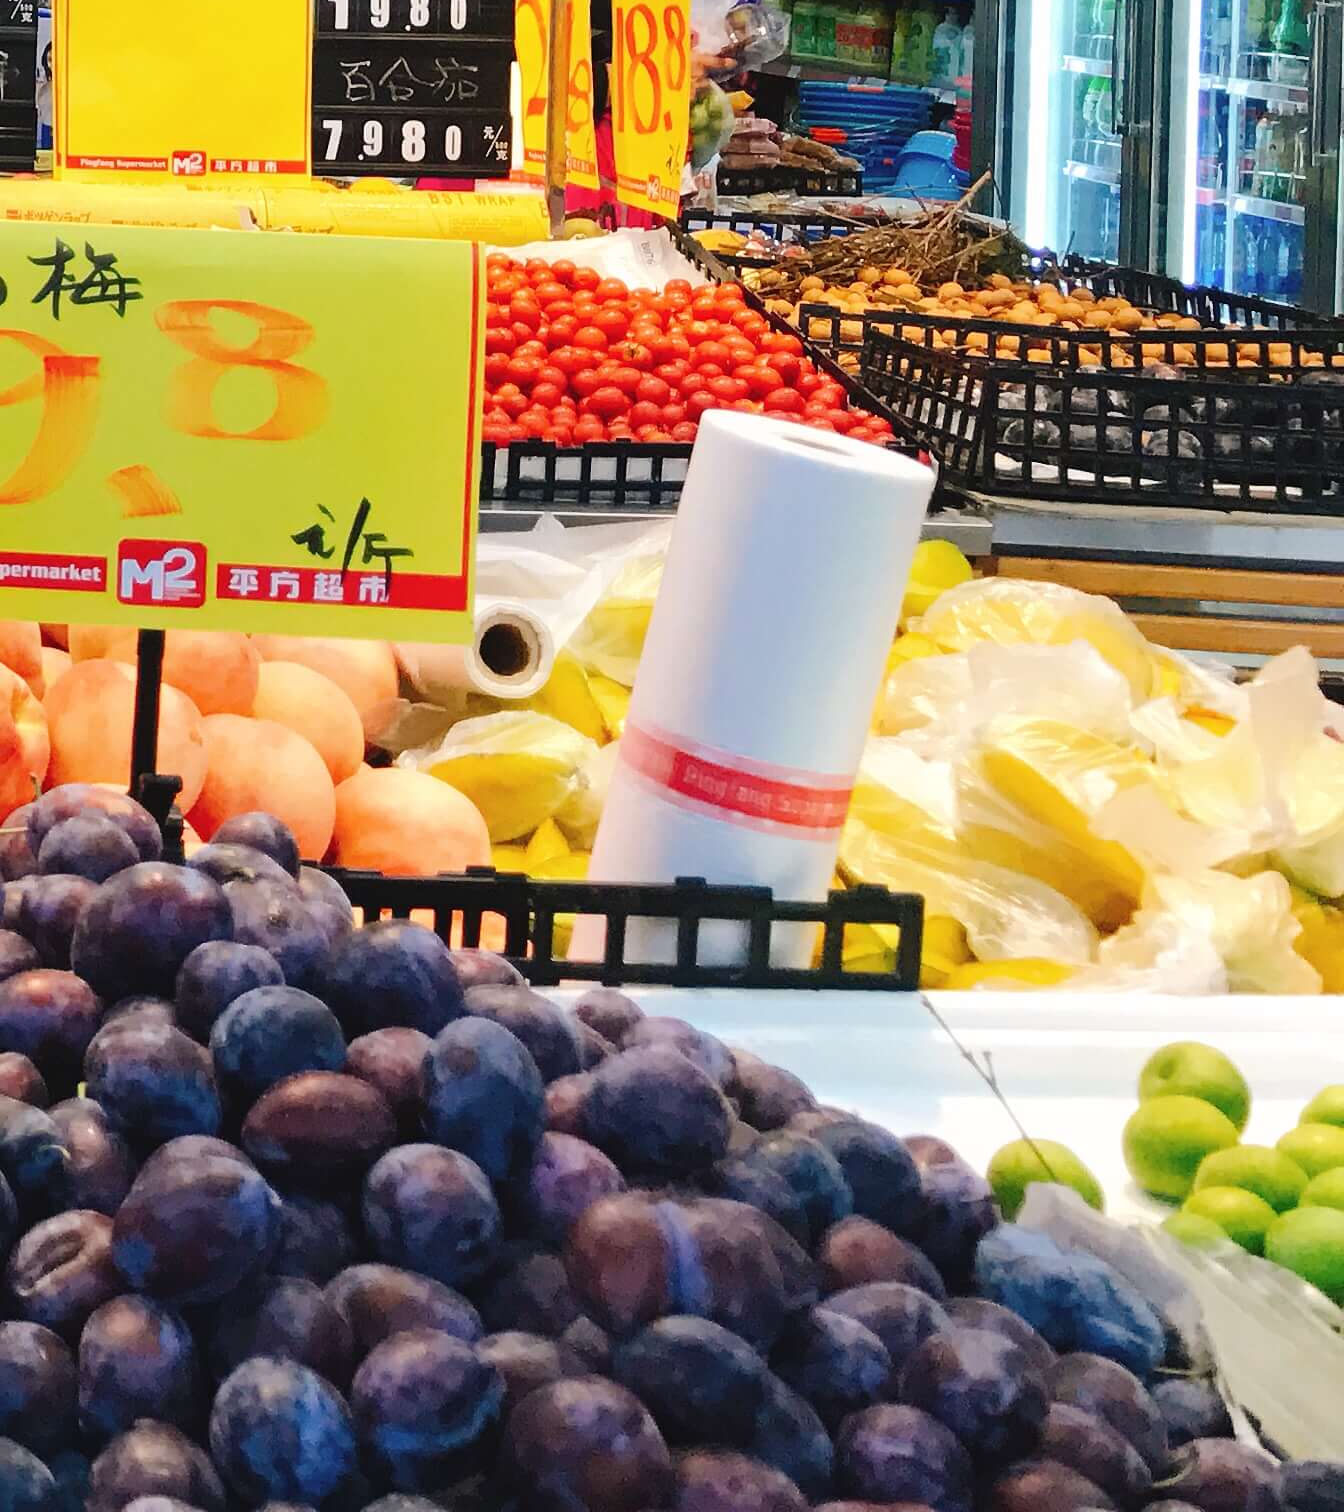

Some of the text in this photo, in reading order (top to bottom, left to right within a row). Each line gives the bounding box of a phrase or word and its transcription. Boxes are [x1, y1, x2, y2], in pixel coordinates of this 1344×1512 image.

[617, 4, 686, 135] 18.8
[174, 154, 204, 174] M2
[214, 159, 278, 172] 平方超市
[121, 548, 196, 600] M2
[229, 571, 389, 602] 平方超市
[290, 497, 414, 600] 元/斤
